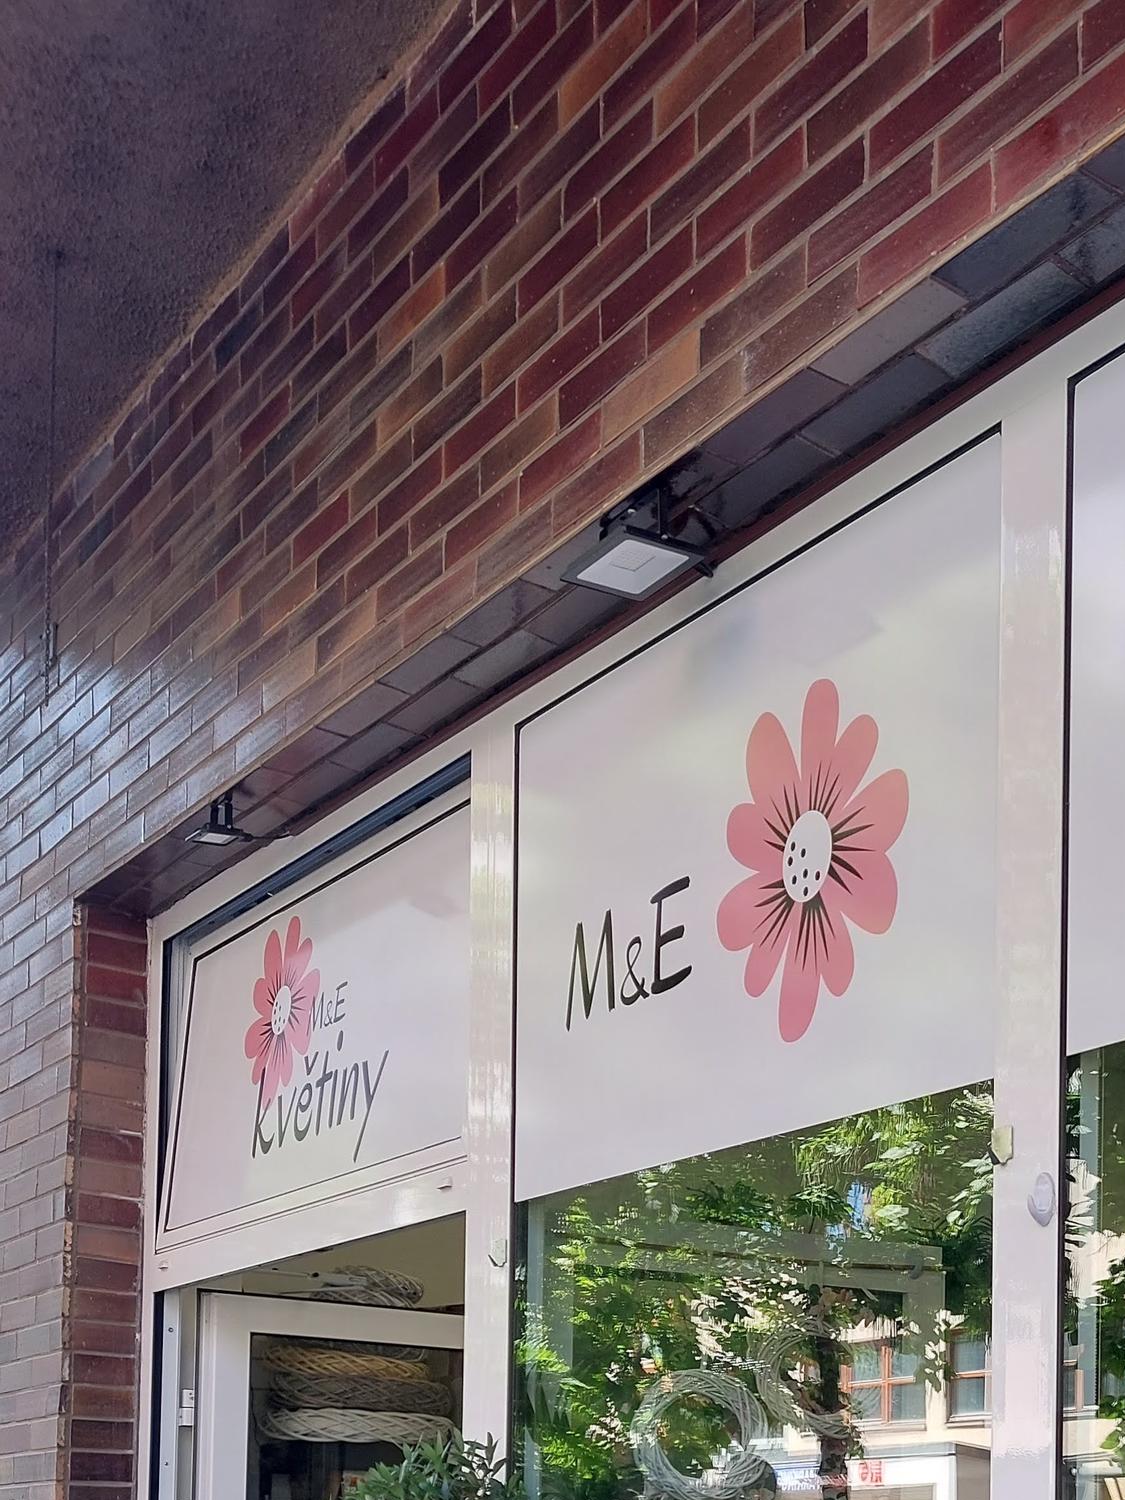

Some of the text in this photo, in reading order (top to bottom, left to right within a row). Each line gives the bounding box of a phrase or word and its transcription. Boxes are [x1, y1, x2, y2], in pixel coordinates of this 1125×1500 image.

[306, 981, 348, 1037] M&E
[566, 876, 692, 1032] M&E
[252, 1030, 389, 1163] květiny
